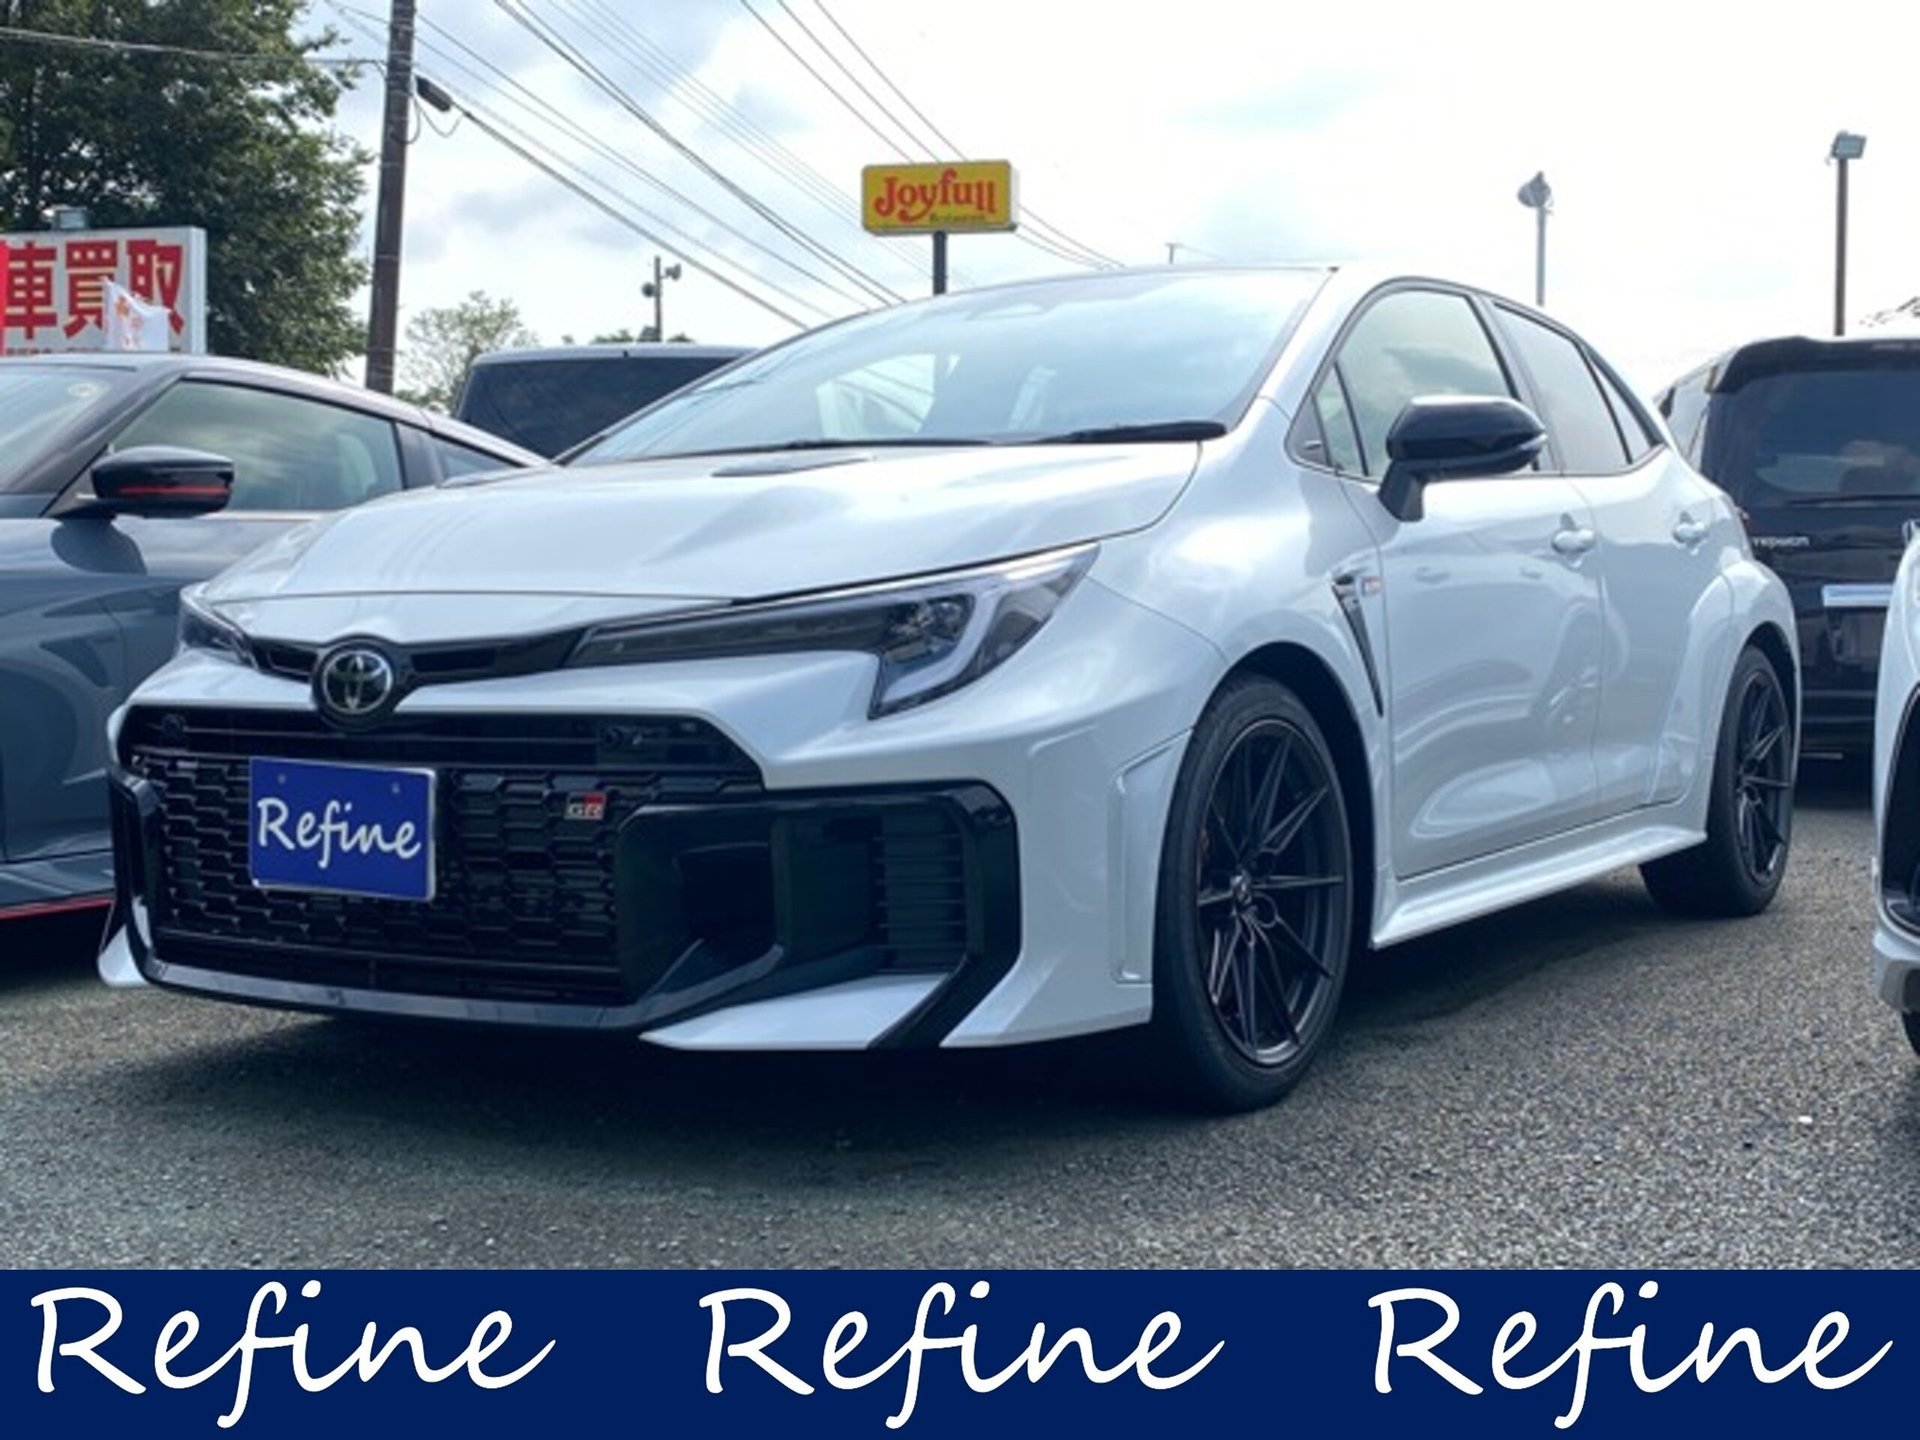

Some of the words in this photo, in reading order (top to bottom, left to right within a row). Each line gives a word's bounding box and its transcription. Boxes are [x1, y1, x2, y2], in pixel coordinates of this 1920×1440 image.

[873, 167, 997, 223] Joyfull
[4, 239, 184, 340] 車買取
[257, 797, 422, 869] Refine
